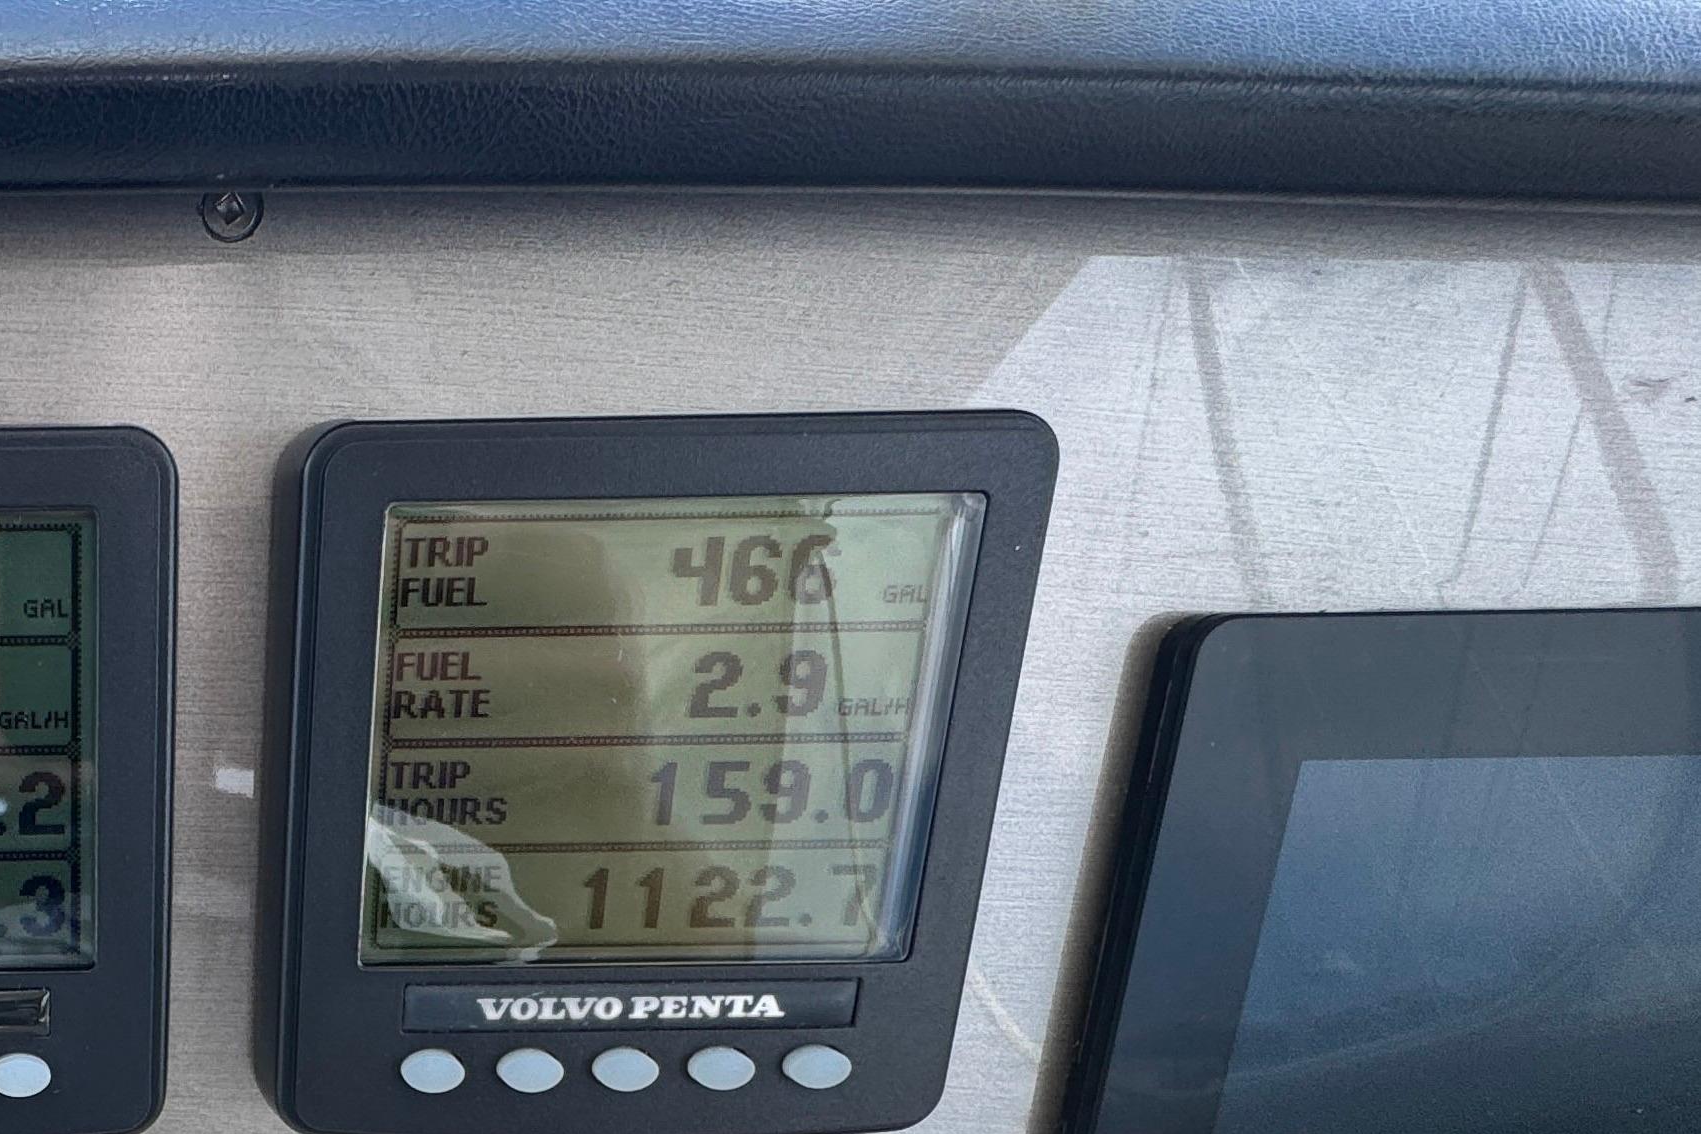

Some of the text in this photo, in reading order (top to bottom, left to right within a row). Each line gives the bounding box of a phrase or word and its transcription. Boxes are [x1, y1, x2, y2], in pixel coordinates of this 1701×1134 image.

[405, 536, 489, 568] TRIP
[672, 535, 930, 606] 466 GAL
[400, 577, 488, 607] FUEL
[23, 599, 69, 619] GAL
[396, 651, 482, 682] FUEL
[689, 650, 828, 718] 2.9
[392, 689, 491, 719] RATE
[390, 761, 470, 790] TRIP
[650, 760, 895, 826] 159.0
[379, 797, 508, 826] HOURS
[582, 863, 879, 930] 1122.7
[476, 994, 786, 1021] VOLVO PENTA
